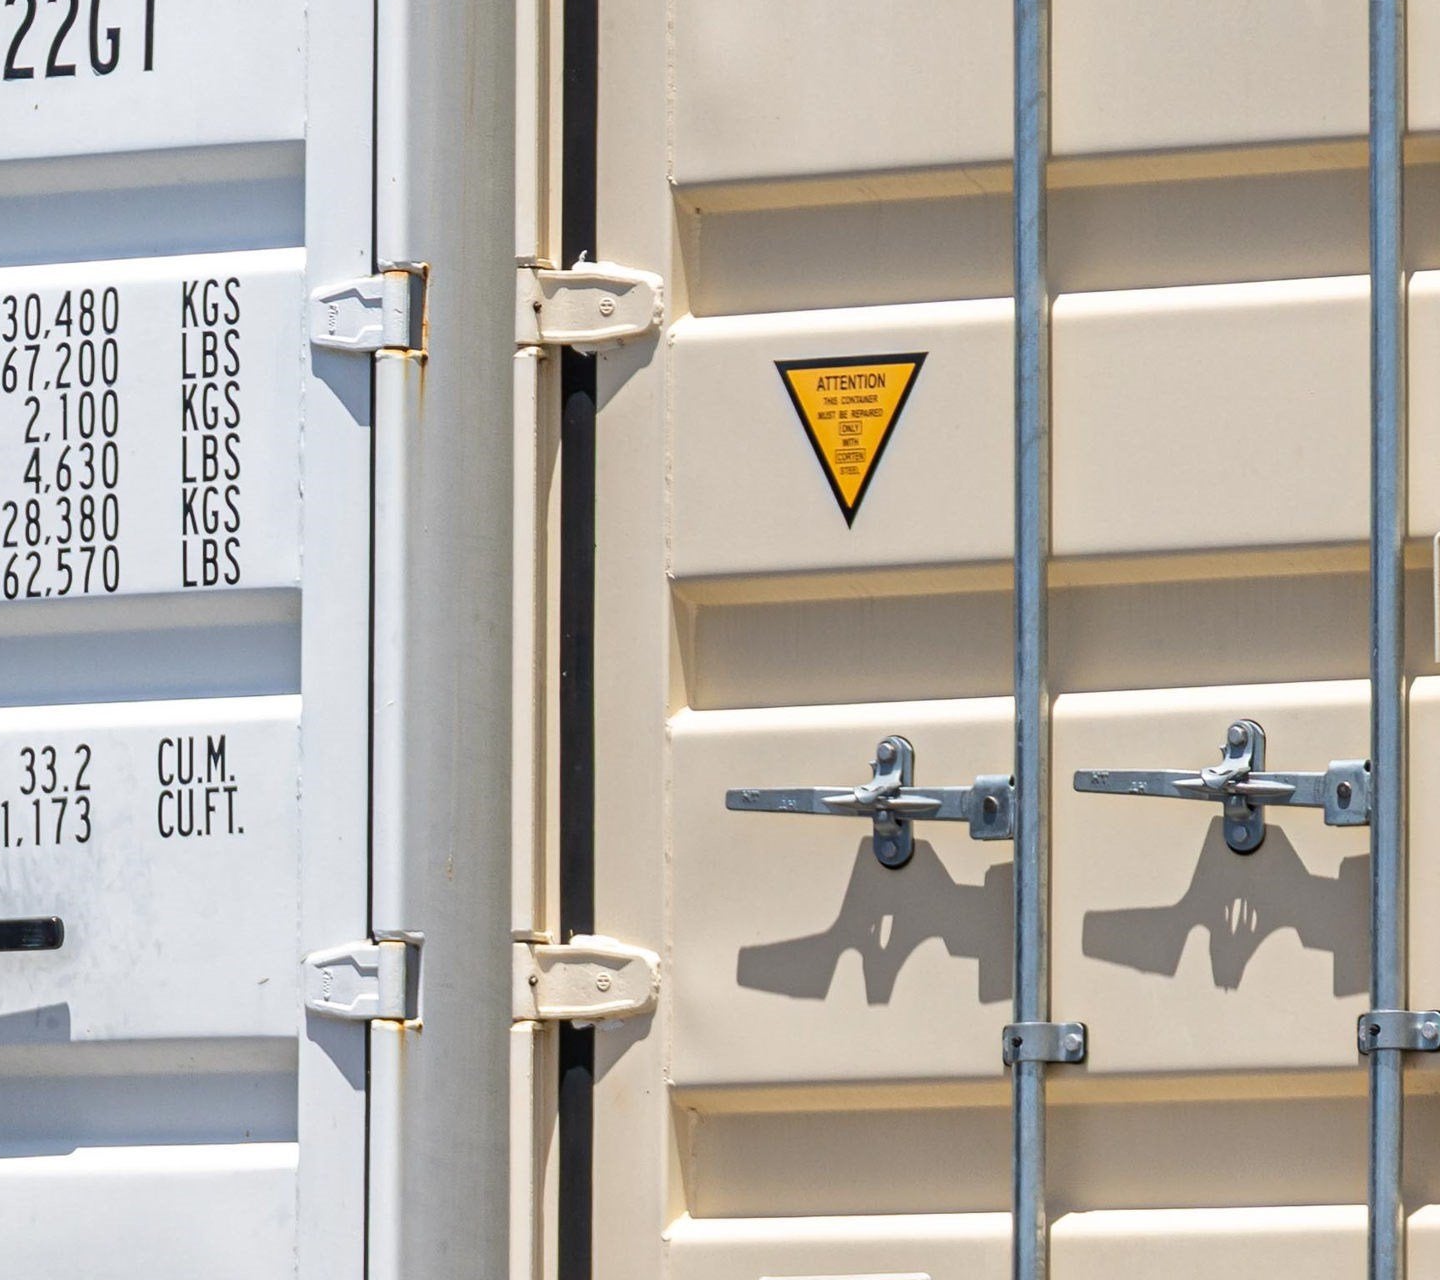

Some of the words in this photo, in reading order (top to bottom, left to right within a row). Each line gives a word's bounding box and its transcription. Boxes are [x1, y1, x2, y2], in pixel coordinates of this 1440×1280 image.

[2, 287, 119, 342] 30,480
[181, 277, 241, 328] KGS
[1, 337, 119, 395] 67,200
[181, 329, 241, 380] LBS
[816, 373, 886, 392] ATTENTION
[24, 390, 119, 444] 2,100
[181, 381, 241, 432] KGS
[817, 410, 836, 420] MUST
[839, 409, 848, 419] BE
[851, 408, 883, 418] REPAIRED
[823, 397, 838, 406] THIS
[841, 394, 878, 405] CONTAINER
[841, 423, 859, 433] ONLY
[24, 441, 119, 495] 4,630
[181, 432, 241, 484] LBS
[2, 493, 119, 548] 28,380
[181, 485, 241, 536] KGS
[2, 546, 119, 600] 62,570
[181, 537, 241, 588] LBS
[19, 744, 91, 795] 33.2
[157, 735, 236, 786] CU.M.
[1, 795, 91, 848] 1,173
[157, 786, 245, 838] CU.FT.
